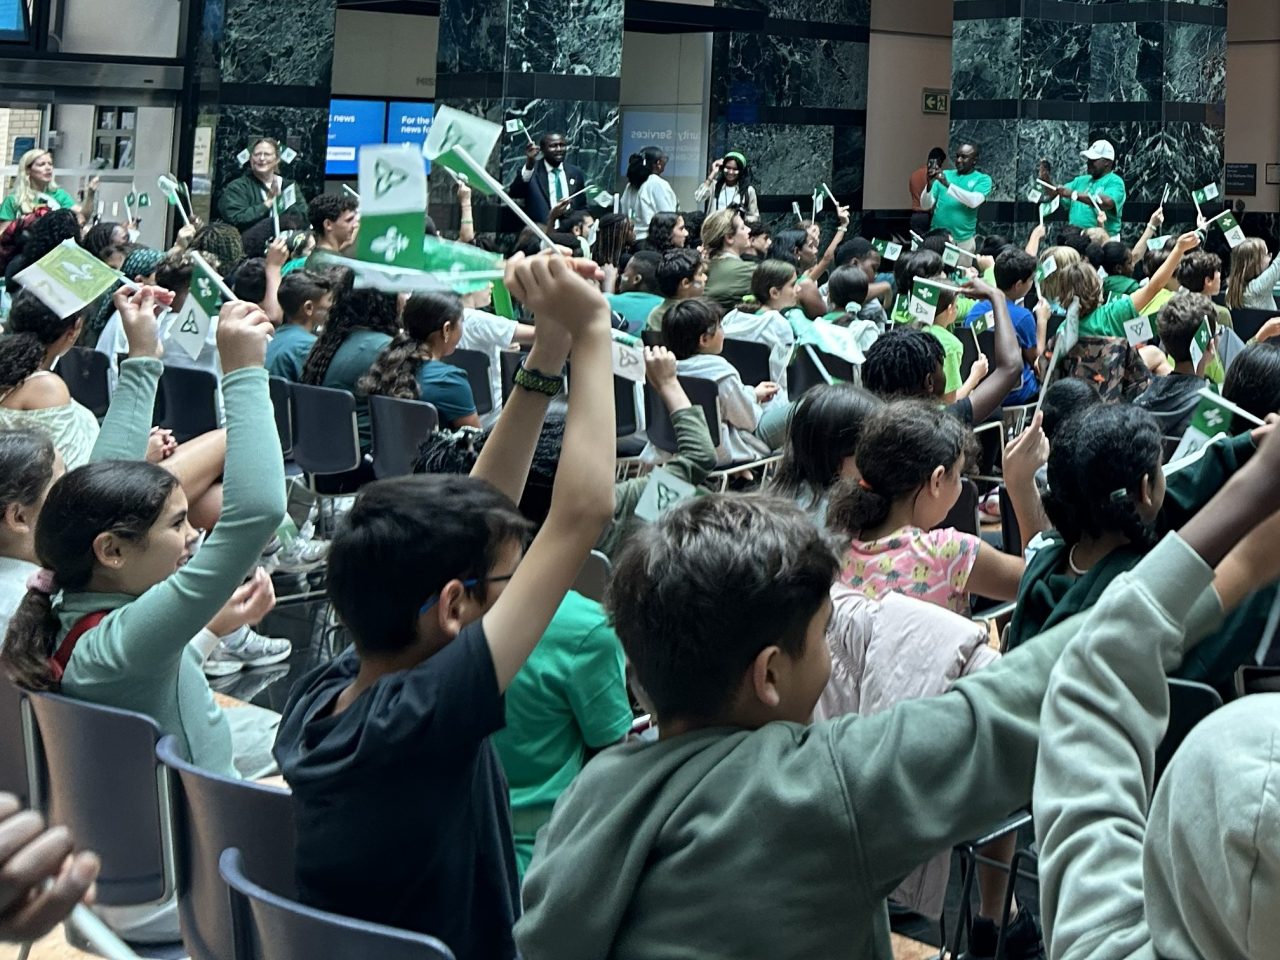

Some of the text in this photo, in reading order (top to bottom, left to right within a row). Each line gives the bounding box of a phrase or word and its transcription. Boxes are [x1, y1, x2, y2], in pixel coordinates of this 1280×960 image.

[333, 115, 355, 123] news
[401, 115, 416, 125] For
[416, 115, 430, 125] the
[401, 126, 421, 134] news
